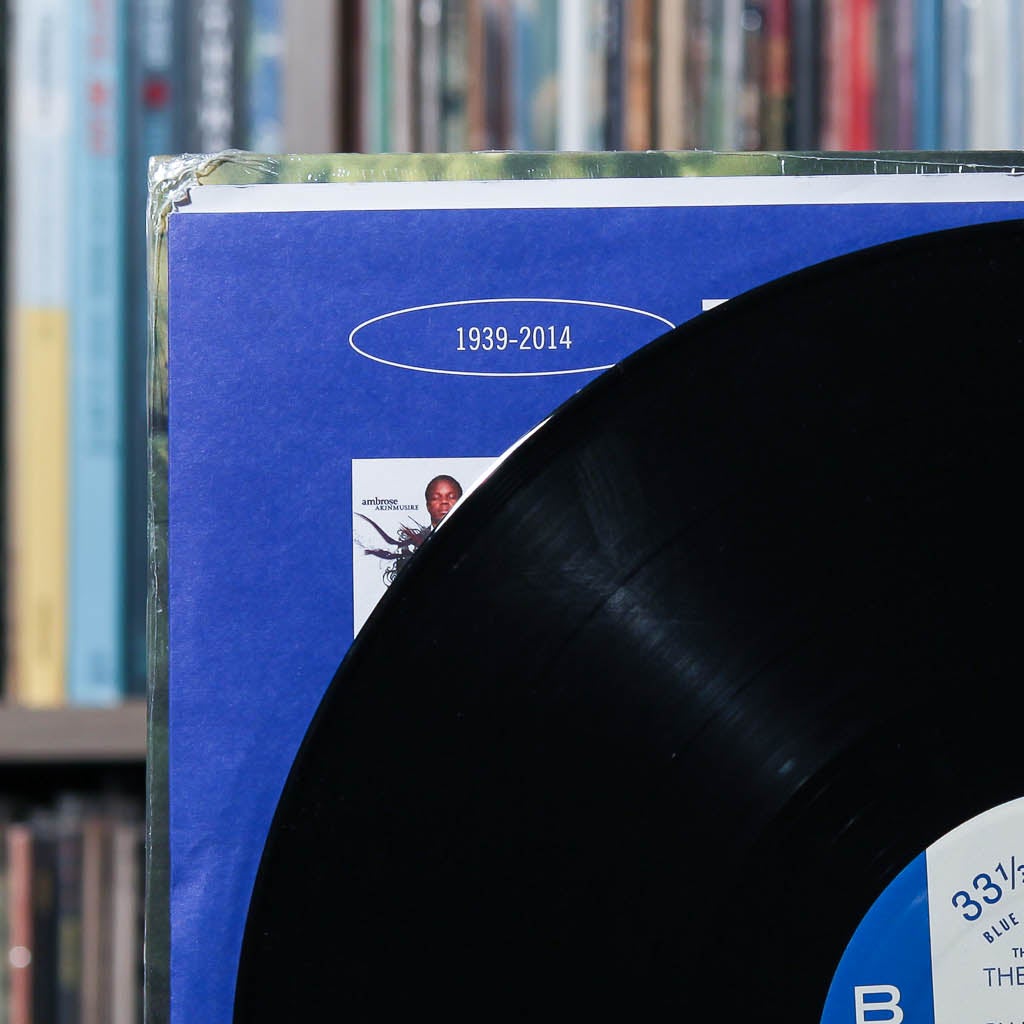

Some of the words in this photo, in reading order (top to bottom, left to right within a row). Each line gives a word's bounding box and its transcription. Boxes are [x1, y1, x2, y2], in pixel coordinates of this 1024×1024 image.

[455, 325, 572, 352] 1939-2014
[362, 497, 398, 505] ambrose
[982, 912, 1020, 944] BLUE
